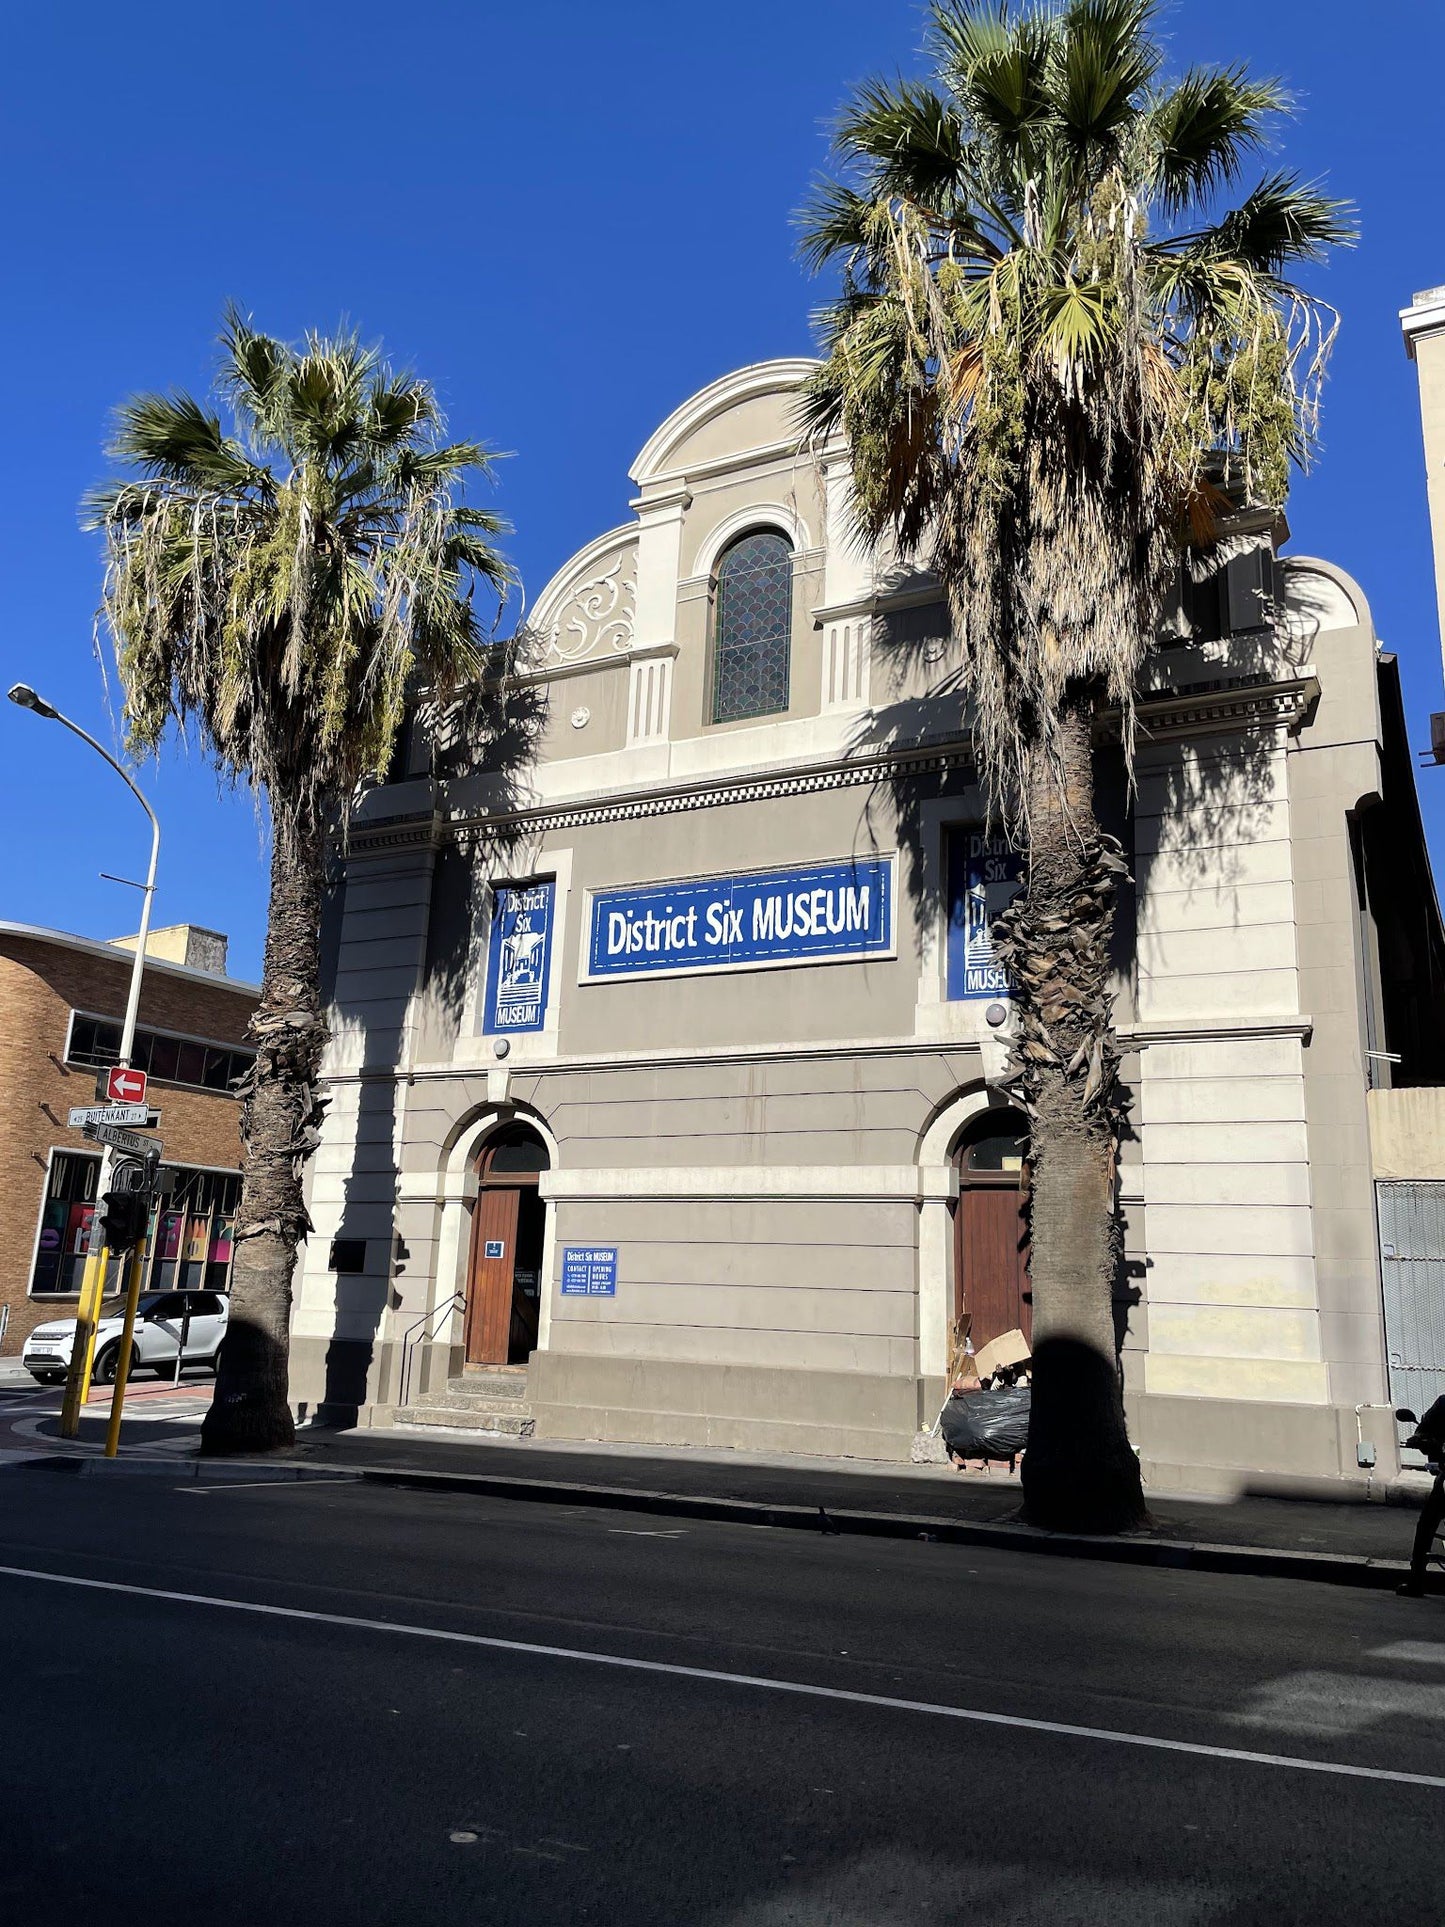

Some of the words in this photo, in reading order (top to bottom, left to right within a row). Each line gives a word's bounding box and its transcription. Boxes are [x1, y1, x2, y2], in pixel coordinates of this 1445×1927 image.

[984, 857, 1007, 881] Six
[507, 890, 545, 913] District
[514, 913, 532, 933] Six
[607, 905, 698, 955] District
[704, 899, 744, 946] Six
[752, 885, 870, 941] MUSEUM
[967, 968, 1017, 991] MUSEU
[497, 1005, 536, 1025] MUSEUM
[85, 1109, 130, 1122] BUITENKANT
[102, 1127, 140, 1148] ALBERTUS
[593, 1252, 613, 1261] MUSEUM
